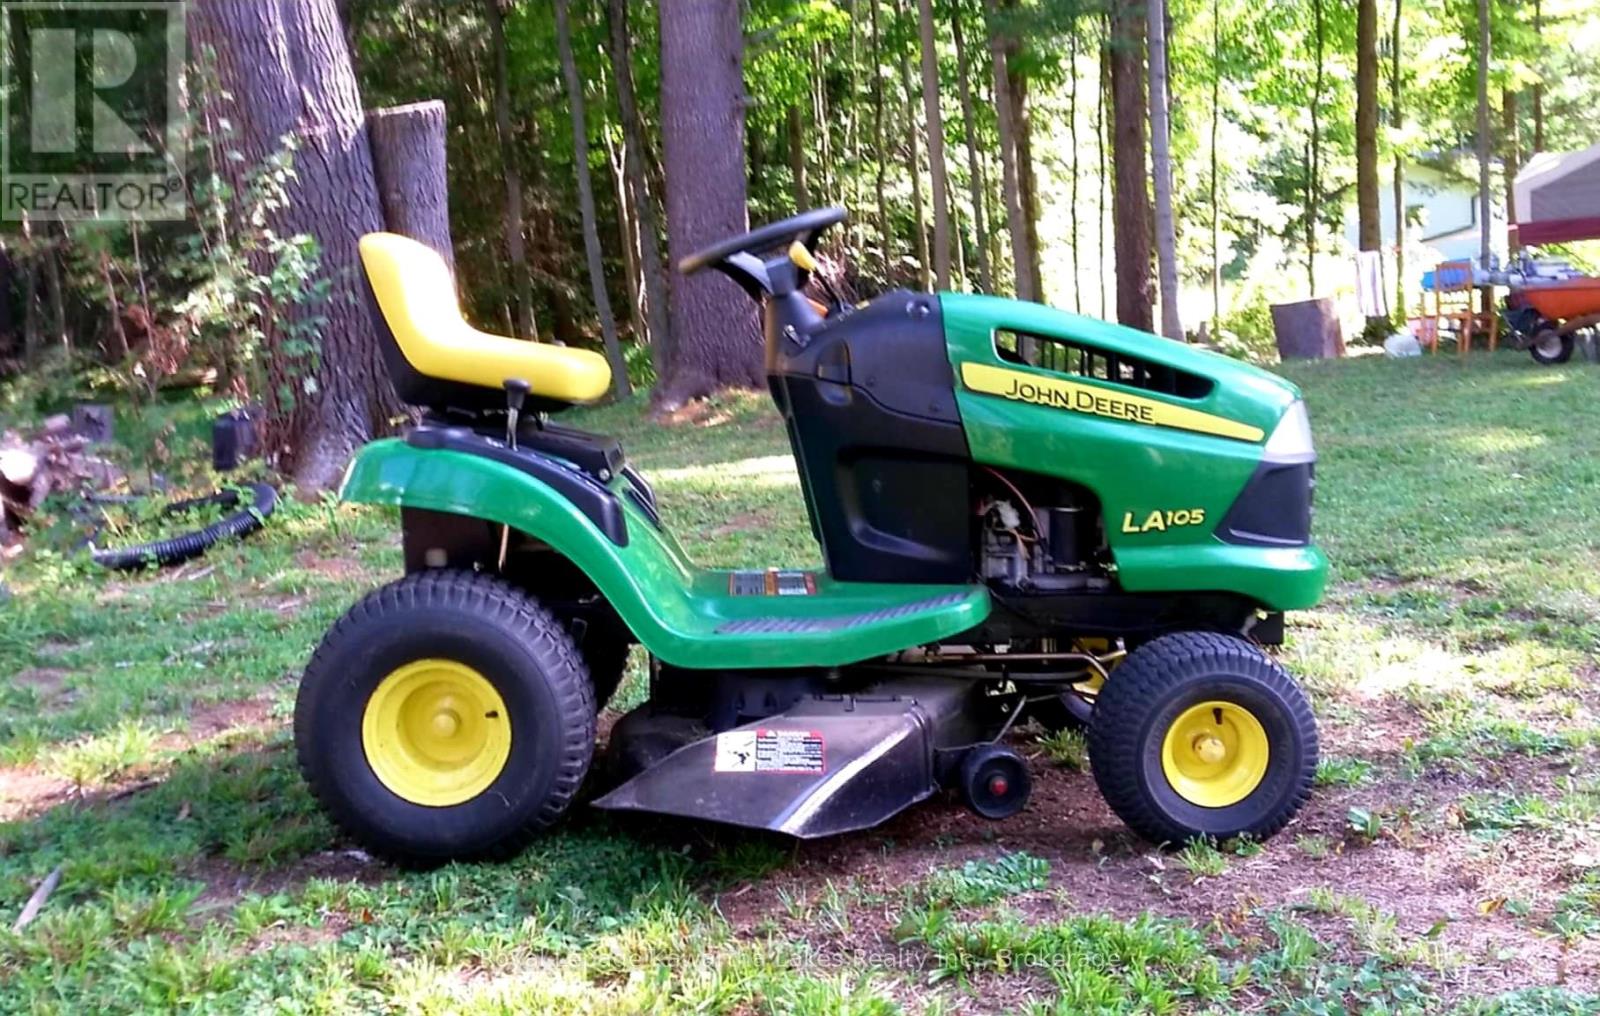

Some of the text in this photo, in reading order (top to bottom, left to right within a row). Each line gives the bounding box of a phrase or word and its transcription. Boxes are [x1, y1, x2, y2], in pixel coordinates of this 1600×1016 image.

[1005, 379, 1154, 421] JOHN DEERE
[1122, 508, 1205, 533] LA105
